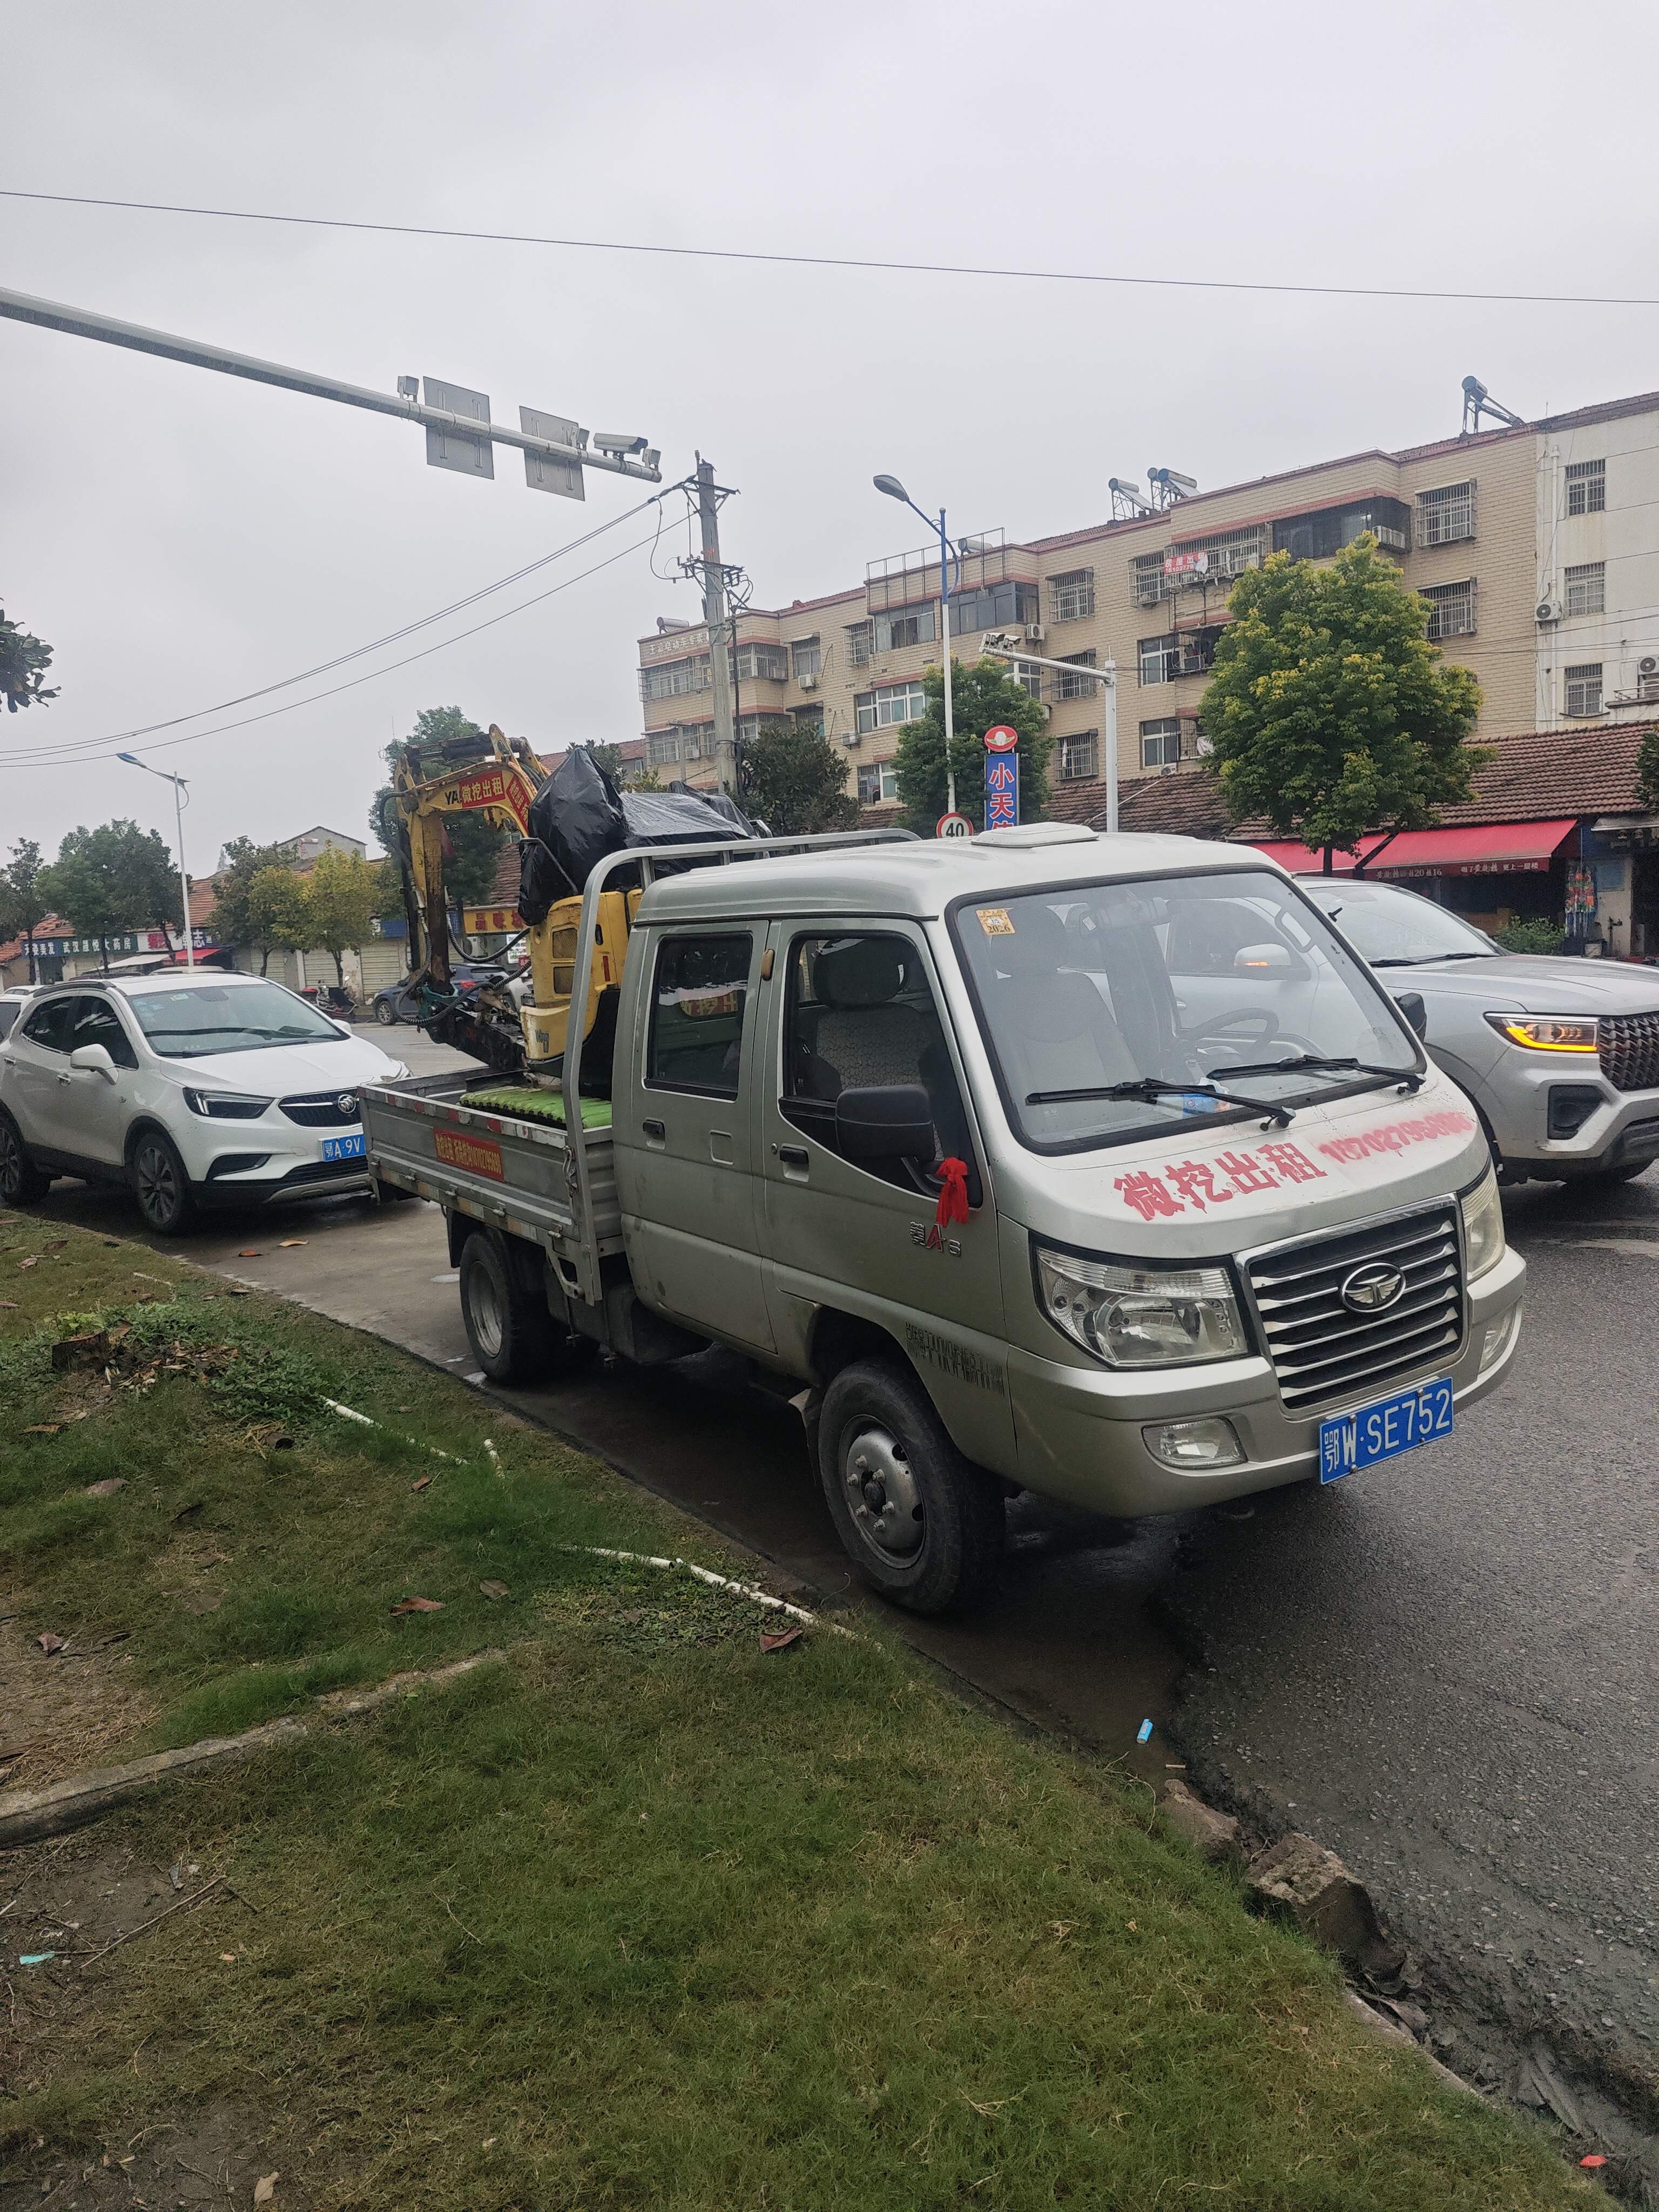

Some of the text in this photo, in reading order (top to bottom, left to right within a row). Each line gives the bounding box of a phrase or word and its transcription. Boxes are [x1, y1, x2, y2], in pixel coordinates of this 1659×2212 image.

[462, 777, 503, 803] 微挖出租
[946, 822, 965, 837] 40
[987, 924, 1010, 933] 2026
[1114, 1142, 1328, 1221] 微挖出租
